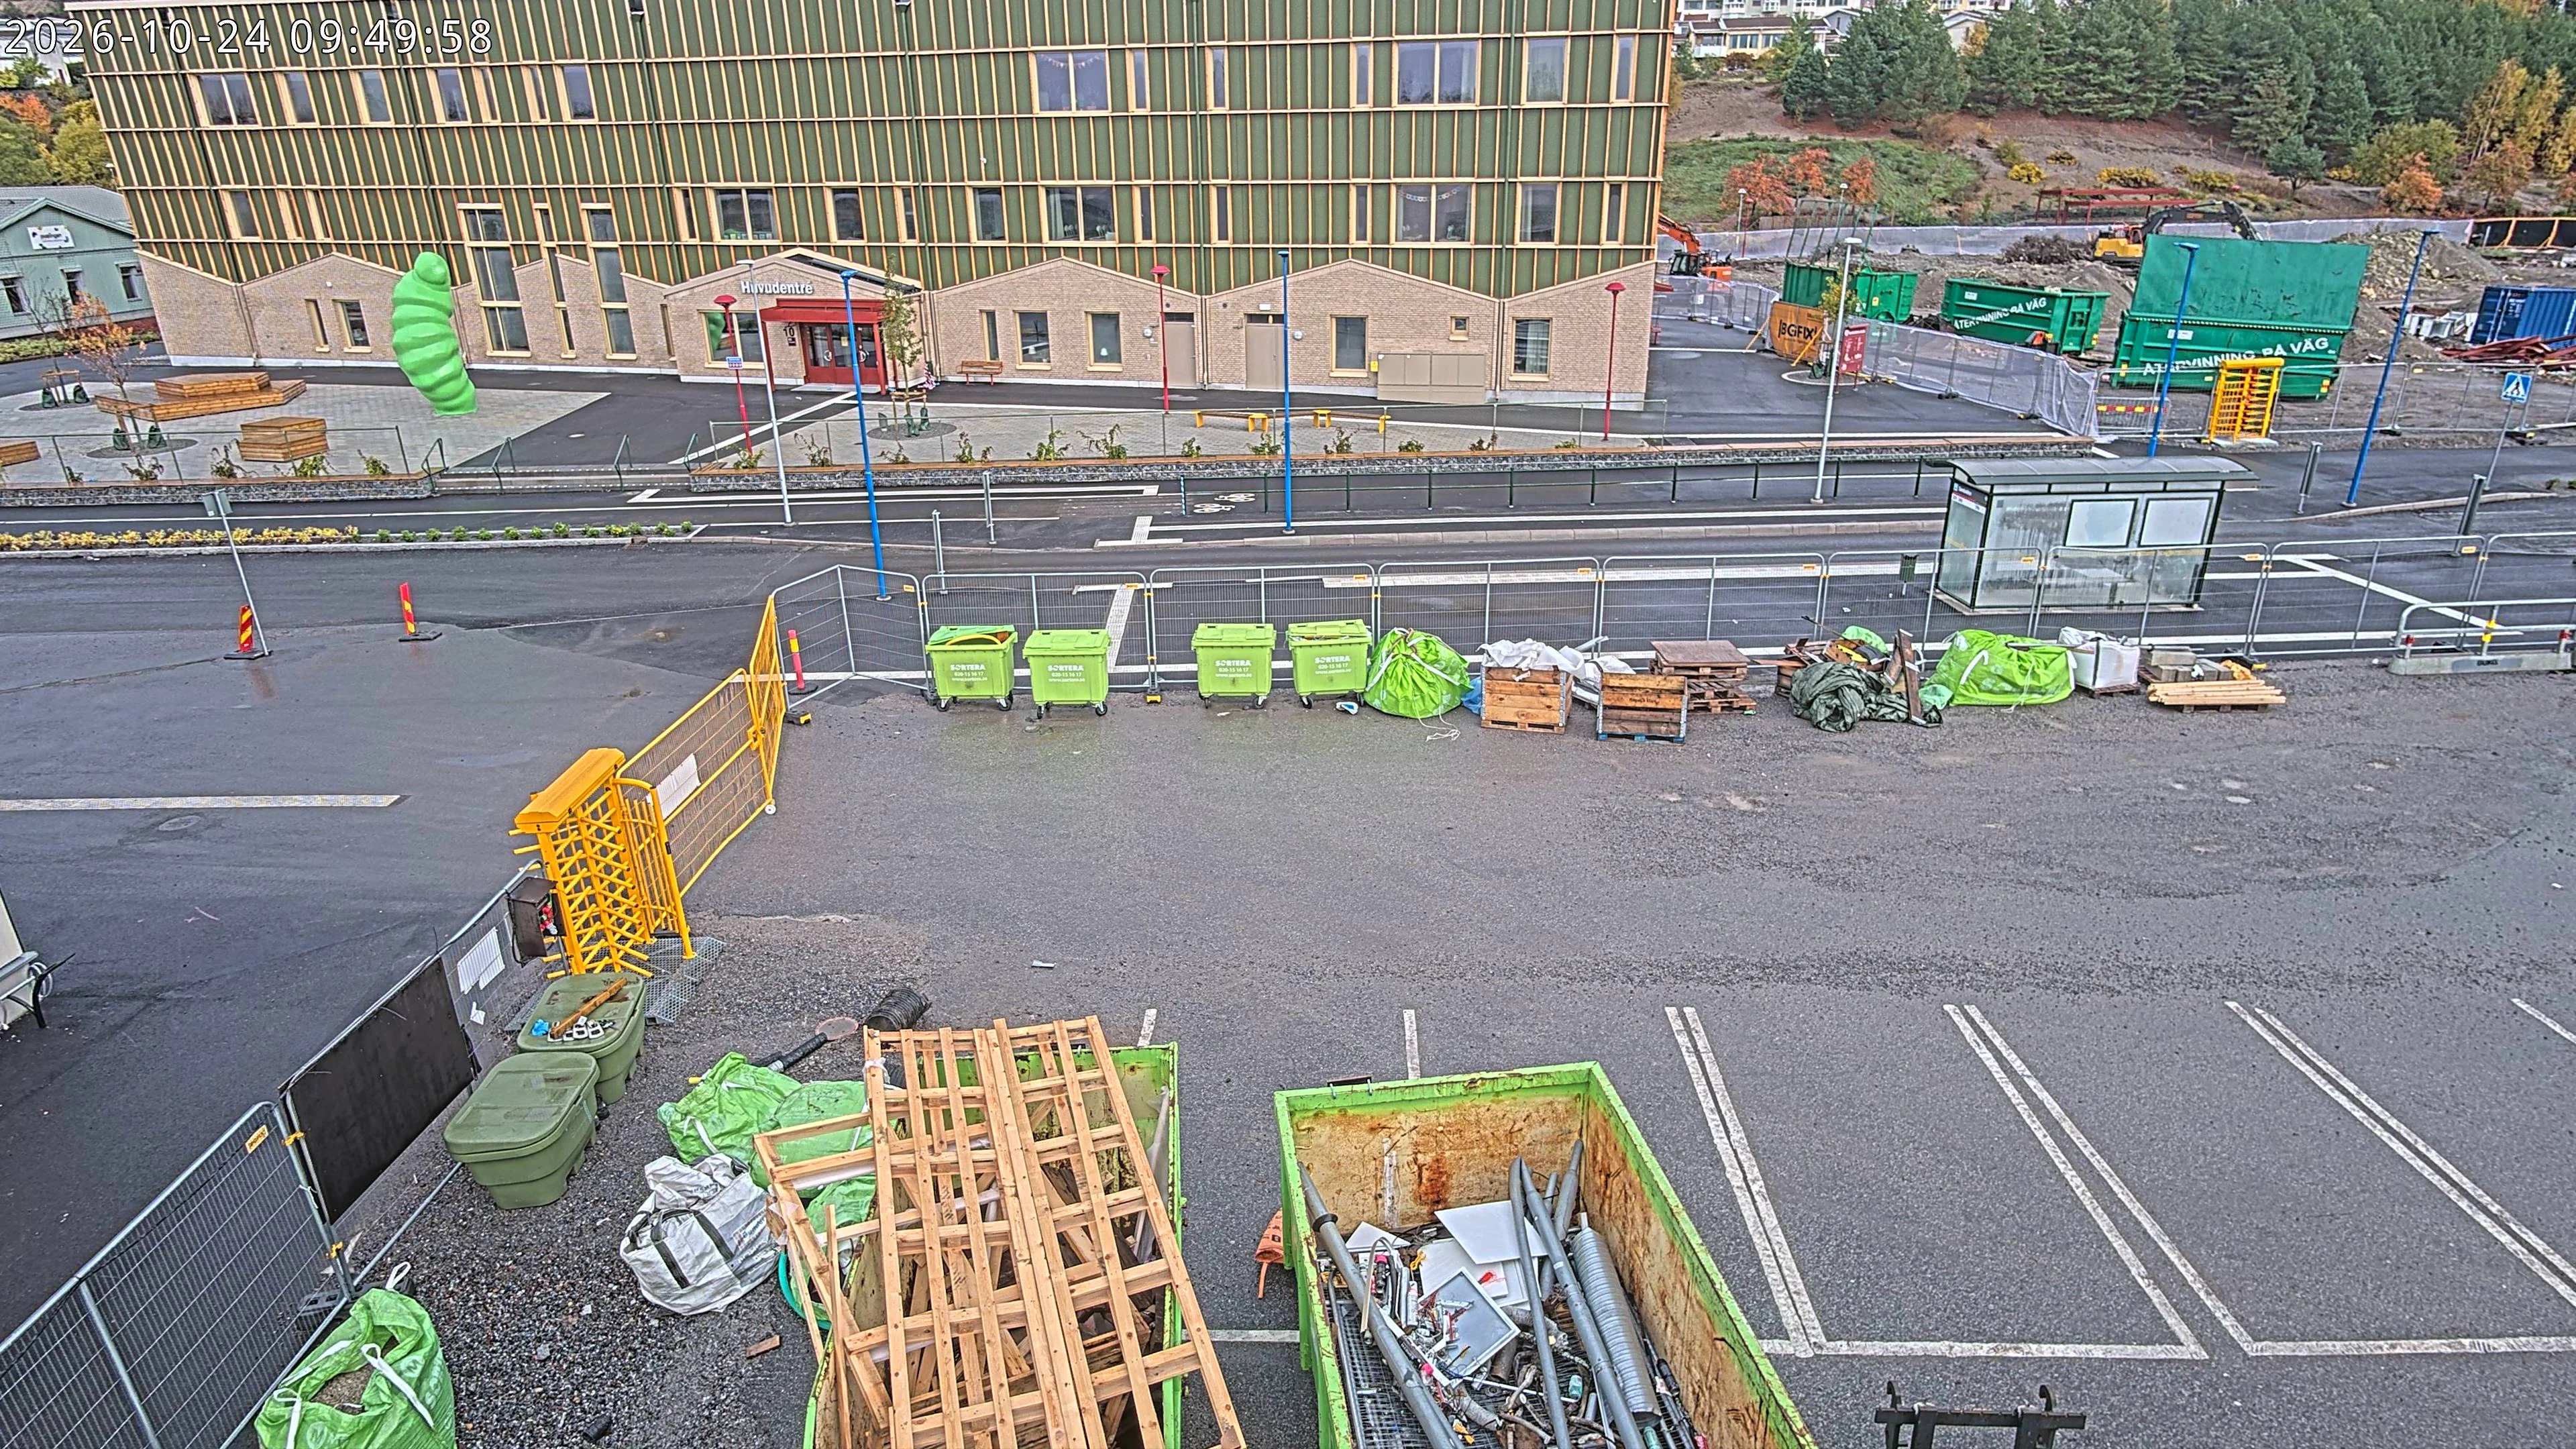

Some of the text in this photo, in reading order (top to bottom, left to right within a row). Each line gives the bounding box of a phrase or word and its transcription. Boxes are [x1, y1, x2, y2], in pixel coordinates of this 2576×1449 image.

[741, 280, 814, 294] Huvudentré
[784, 327, 795, 337] 10
[2290, 337, 2329, 354] VÄG
[1314, 655, 1351, 663] SORTERA
